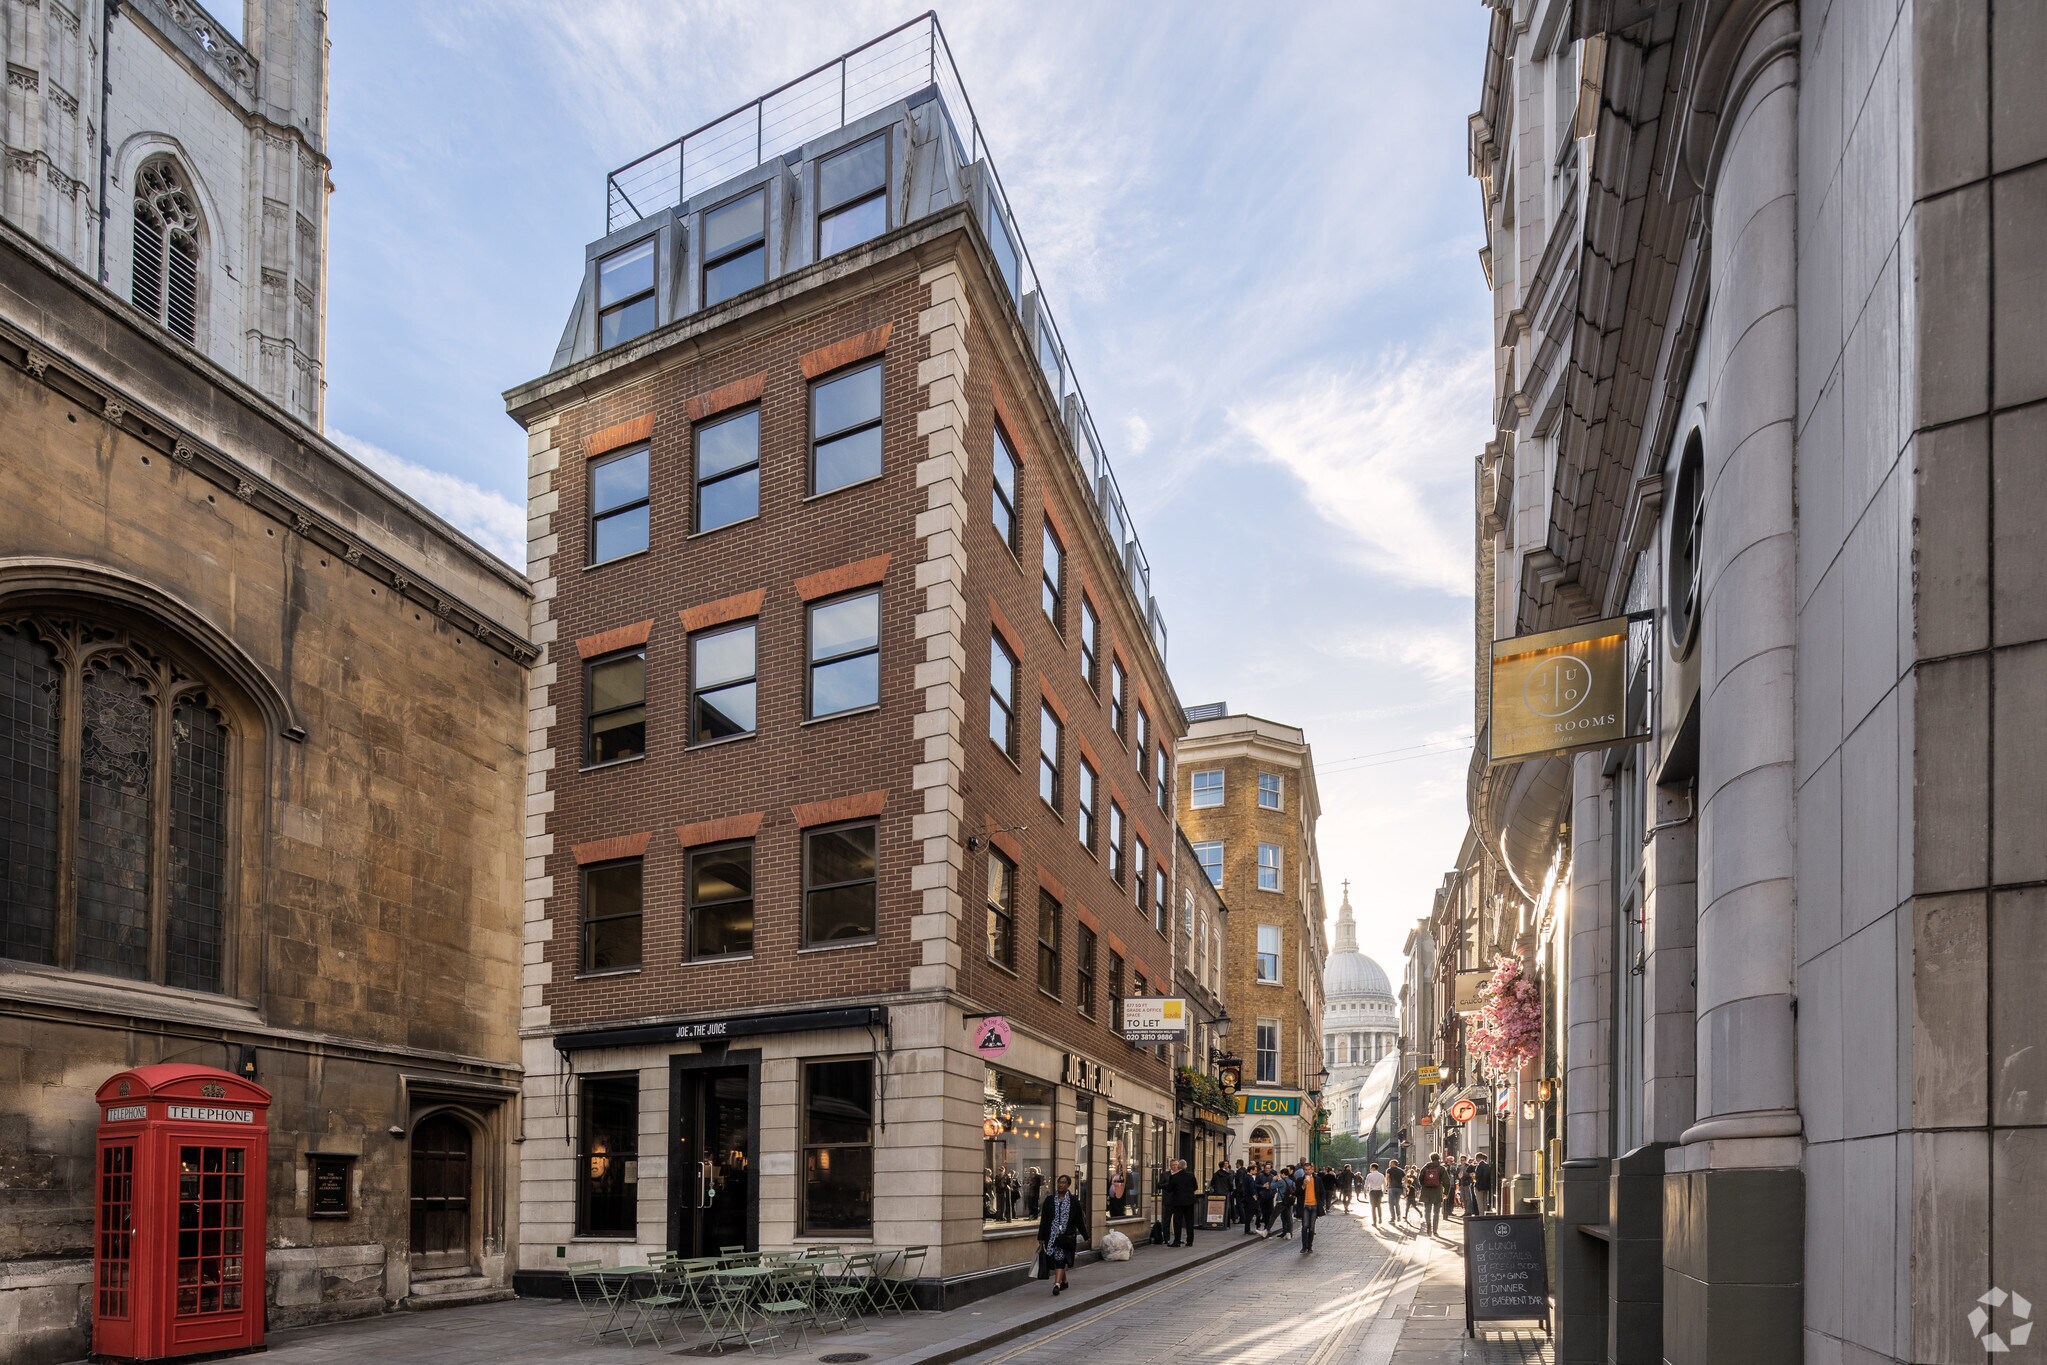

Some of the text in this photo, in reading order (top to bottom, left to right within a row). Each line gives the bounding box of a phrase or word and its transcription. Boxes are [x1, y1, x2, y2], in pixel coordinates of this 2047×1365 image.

[1554, 714, 1616, 732] ROOMS
[1126, 1019, 1160, 1027] TO LET
[676, 1026, 689, 1038] JOE
[694, 1024, 706, 1036] THE
[707, 1022, 727, 1035] JUICE
[1067, 1053, 1116, 1098] JOE & THE JUICE
[1253, 1099, 1289, 1113] LEON
[109, 1106, 146, 1121] TELEPHONE
[170, 1106, 252, 1122] TELEPHONE
[1488, 1241, 1517, 1250] LUNCH
[1488, 1251, 1532, 1261] COCKTAILS
[1506, 1271, 1529, 1280] GINS
[1491, 1283, 1527, 1293] DINNER
[1491, 1295, 1544, 1306] BASEMENT BAR
